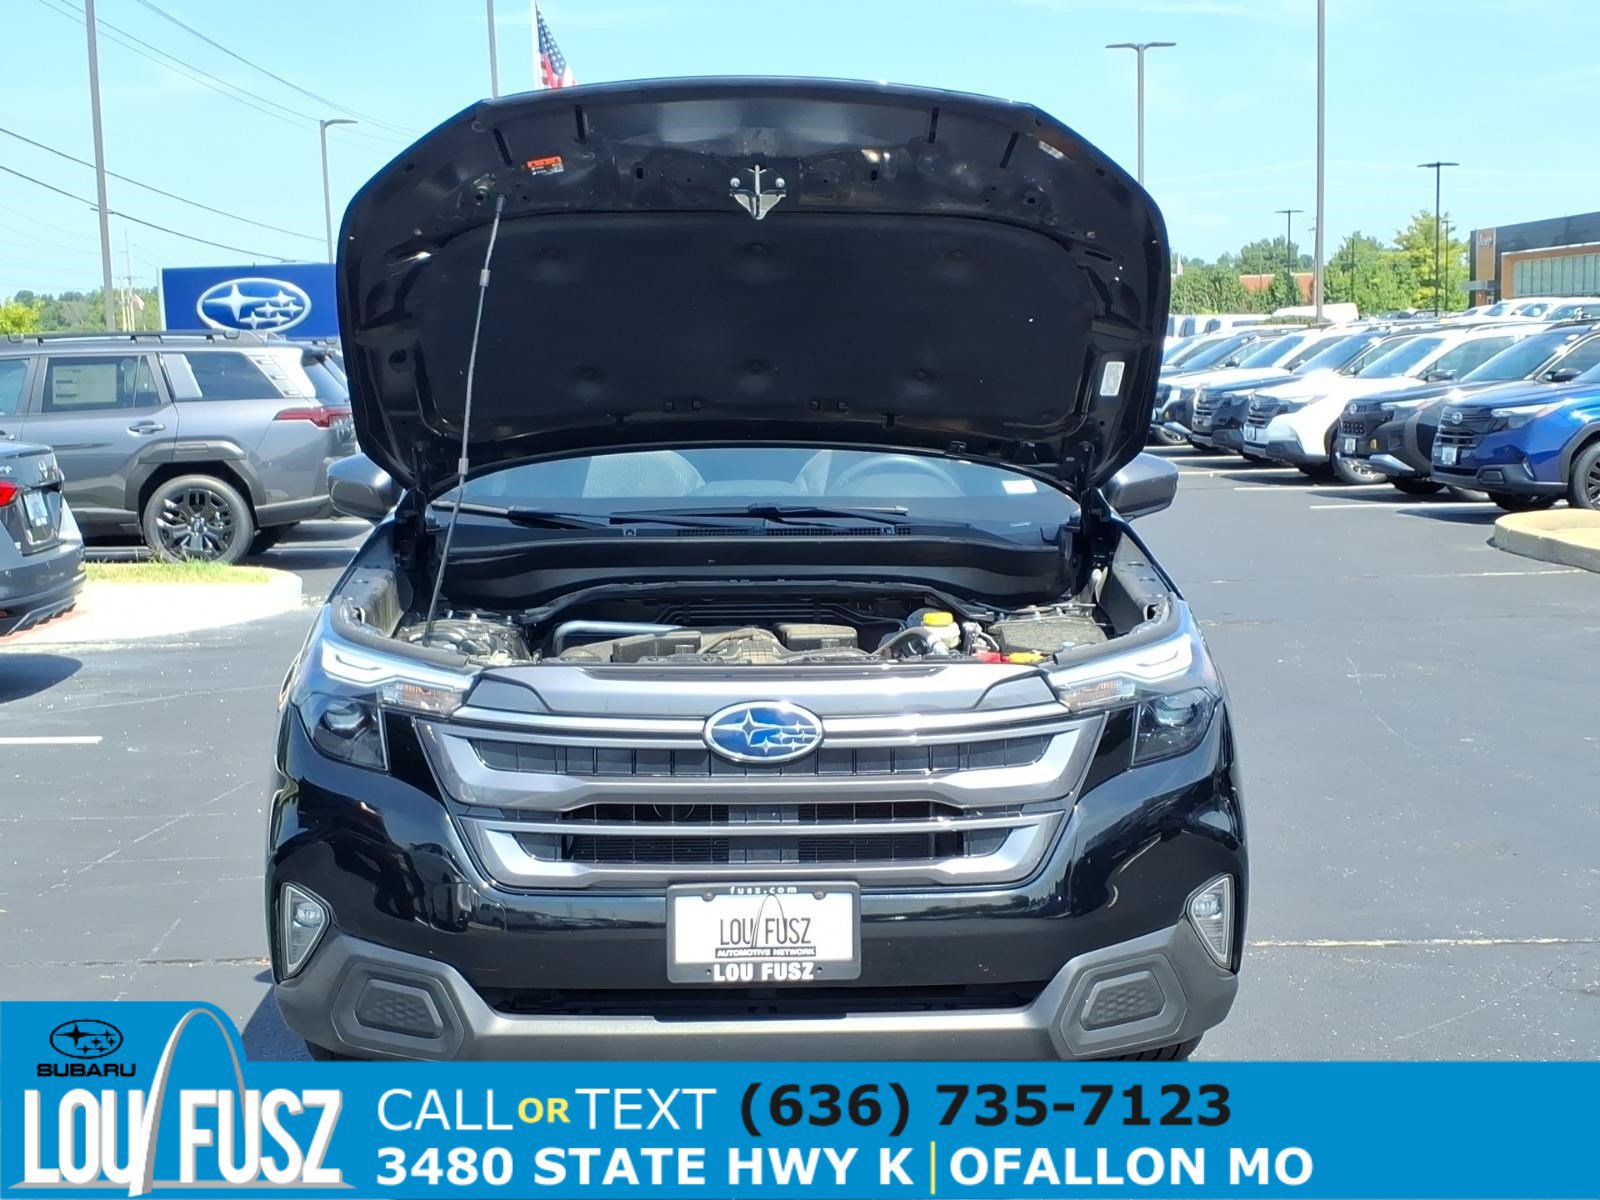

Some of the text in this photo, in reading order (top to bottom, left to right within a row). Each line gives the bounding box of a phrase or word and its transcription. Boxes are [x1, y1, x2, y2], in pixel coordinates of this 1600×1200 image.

[729, 885, 798, 895] fusz.com
[719, 917, 811, 946] LOU FUSZ
[716, 947, 816, 958] AUTOMOTIVE NETWORK
[713, 962, 815, 982] LOU FUSZ
